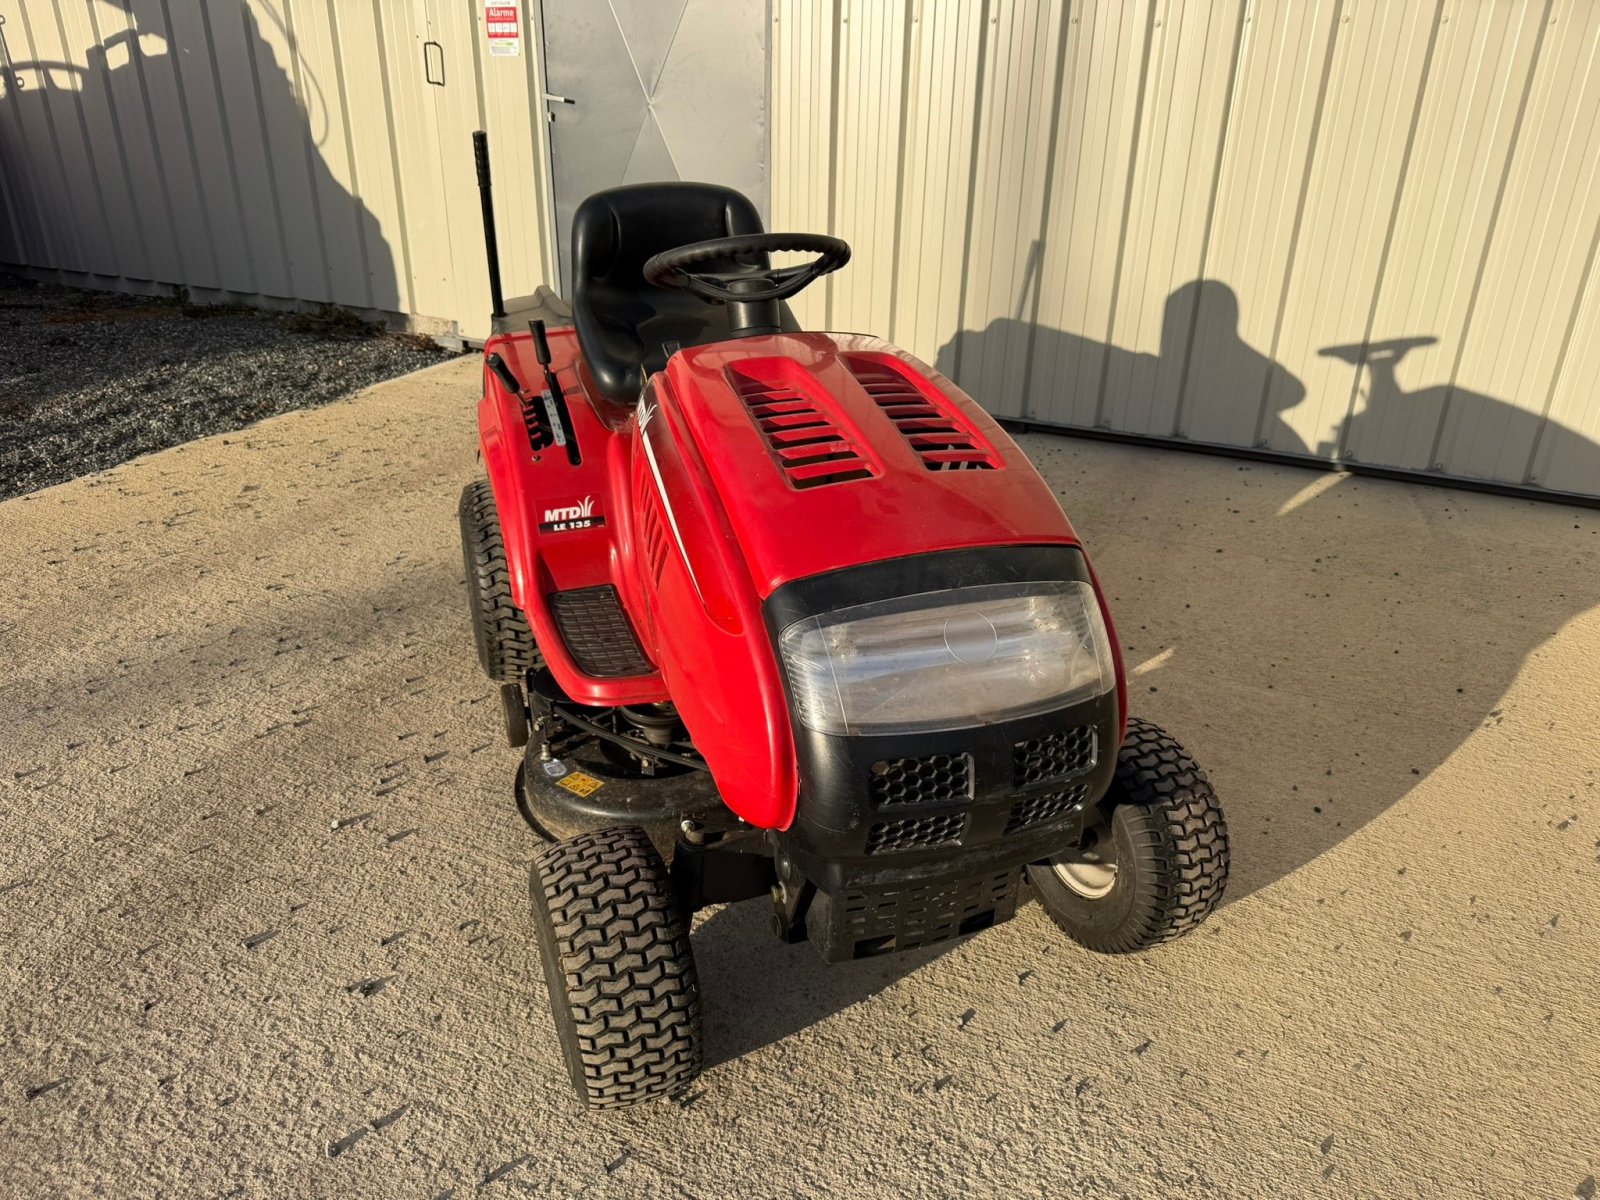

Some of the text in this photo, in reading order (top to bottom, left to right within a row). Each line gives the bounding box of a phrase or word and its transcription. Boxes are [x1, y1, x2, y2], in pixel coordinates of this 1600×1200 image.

[489, 7, 514, 17] Alarme
[544, 506, 581, 522] MTD
[553, 523, 567, 531] LE
[569, 520, 591, 529] 135
